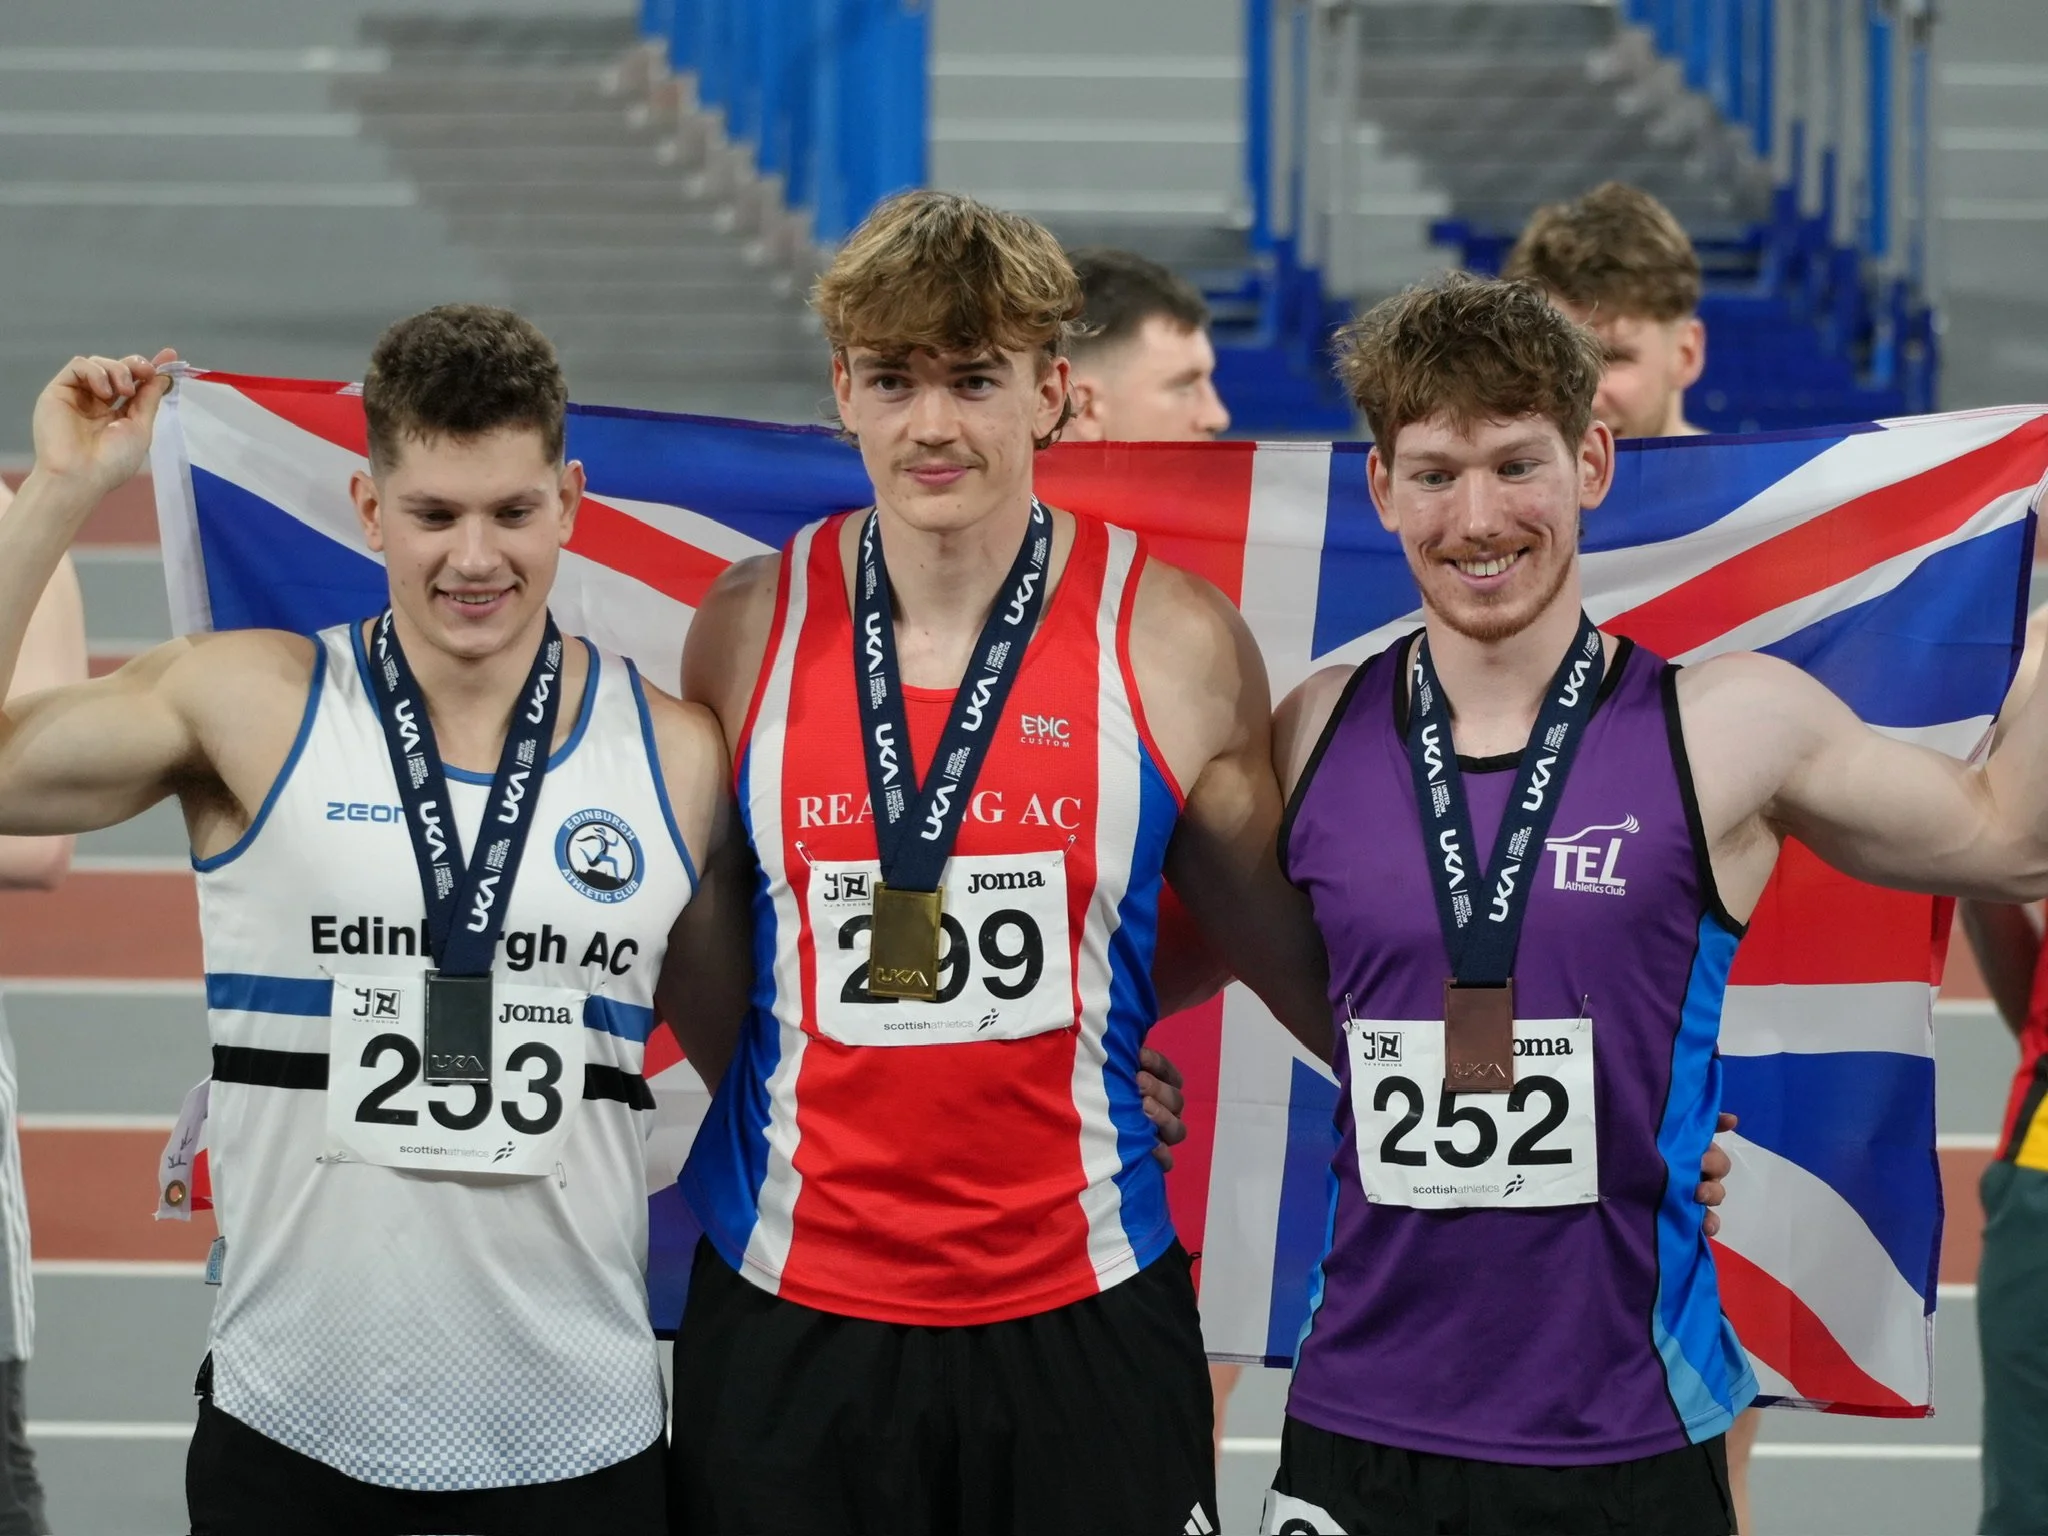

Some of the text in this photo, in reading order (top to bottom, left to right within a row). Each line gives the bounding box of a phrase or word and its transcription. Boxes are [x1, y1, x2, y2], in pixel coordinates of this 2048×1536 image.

[1003, 572, 1040, 626] UKA
[865, 611, 884, 673] UKA
[527, 673, 555, 725] UKA
[961, 676, 999, 732] UKA
[1558, 660, 1591, 708] UKA
[394, 698, 421, 753] UKA
[1019, 736, 1071, 749] CUSTOM
[1020, 713, 1071, 740] EPIC
[1421, 723, 1444, 781] UKA
[875, 722, 899, 785] UKA
[956, 746, 971, 778] ATHLETICS
[497, 771, 531, 824] UKA
[1521, 755, 1557, 812] UKA
[419, 800, 447, 862] UKA
[564, 810, 636, 841] EDINBURGH
[920, 783, 958, 841] UKA
[1018, 792, 1082, 830] AC
[561, 868, 640, 902] ATHLETIC CLUB
[967, 870, 1047, 895] Joma
[1439, 828, 1465, 890] UKA
[1546, 837, 1627, 890] TEL
[466, 875, 501, 933] UKA
[1488, 863, 1521, 923] UKA
[1564, 880, 1627, 897] Athletics Club
[310, 914, 640, 976] Edingh AC
[875, 967, 929, 988] UKA
[498, 1003, 574, 1025] Joma
[430, 1054, 485, 1071] UKA
[1512, 1036, 1574, 1057] oma
[1372, 1074, 1574, 1169] 252
